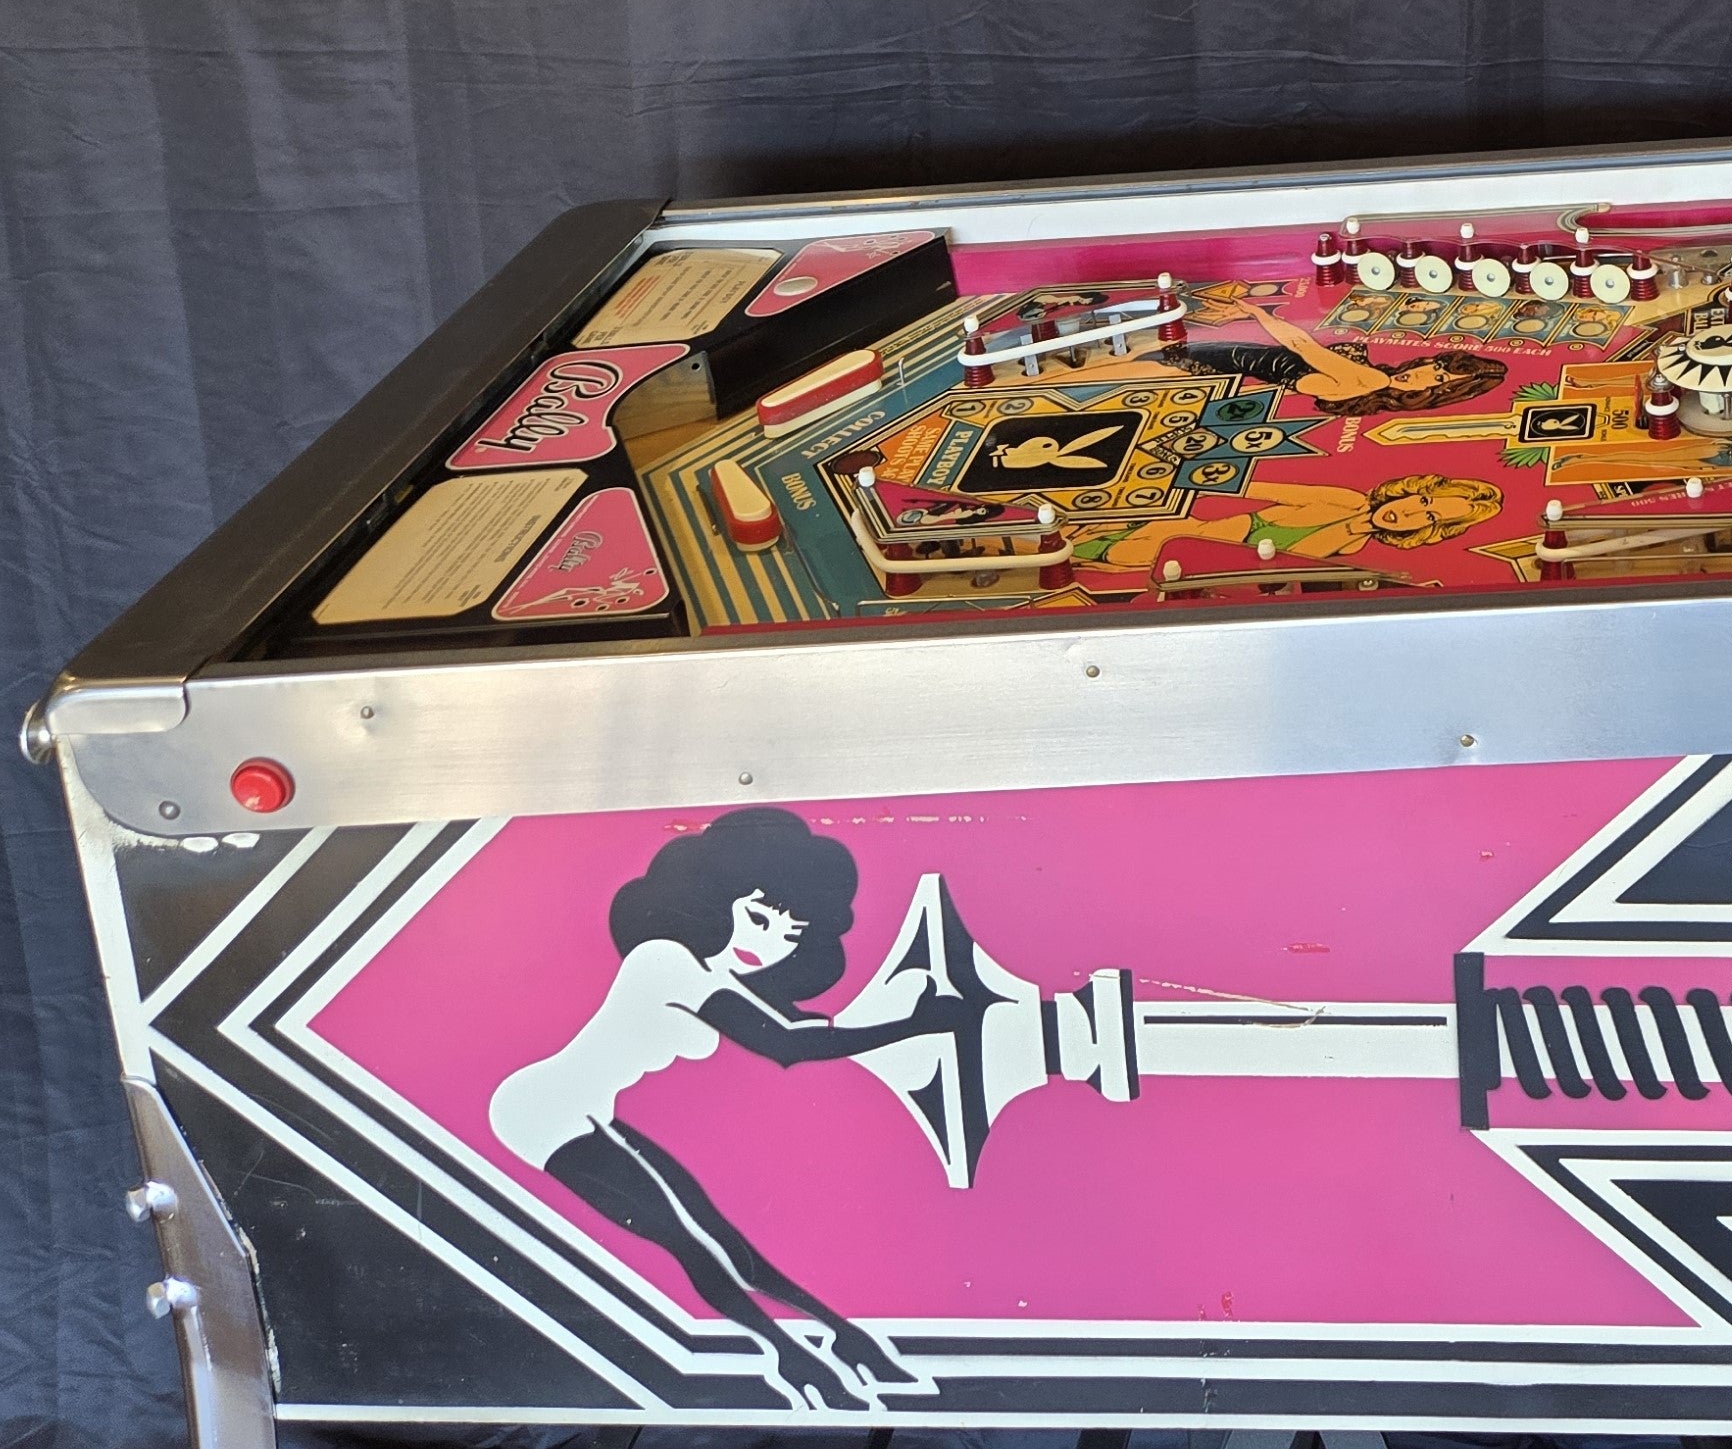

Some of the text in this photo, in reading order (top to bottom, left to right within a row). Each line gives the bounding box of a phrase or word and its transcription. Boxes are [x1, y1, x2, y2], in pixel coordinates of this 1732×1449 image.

[1711, 308, 1726, 325] EXT
[1353, 335, 1552, 356] PLAYMATES SCORE 500 EACH
[474, 359, 624, 453] Bally
[1611, 409, 1629, 430] 500
[801, 410, 886, 459] COLLECT
[890, 425, 927, 466] SHOOTS
[914, 427, 941, 456] SAME
[1184, 435, 1207, 451] 20
[1245, 430, 1273, 449] 5x
[1337, 417, 1362, 453] BONUS
[926, 430, 974, 485] PLAYBOY
[1201, 464, 1231, 484] 3x
[781, 472, 817, 510] BONUS
[1659, 485, 1715, 501] SRES
[548, 531, 603, 572] Bally
